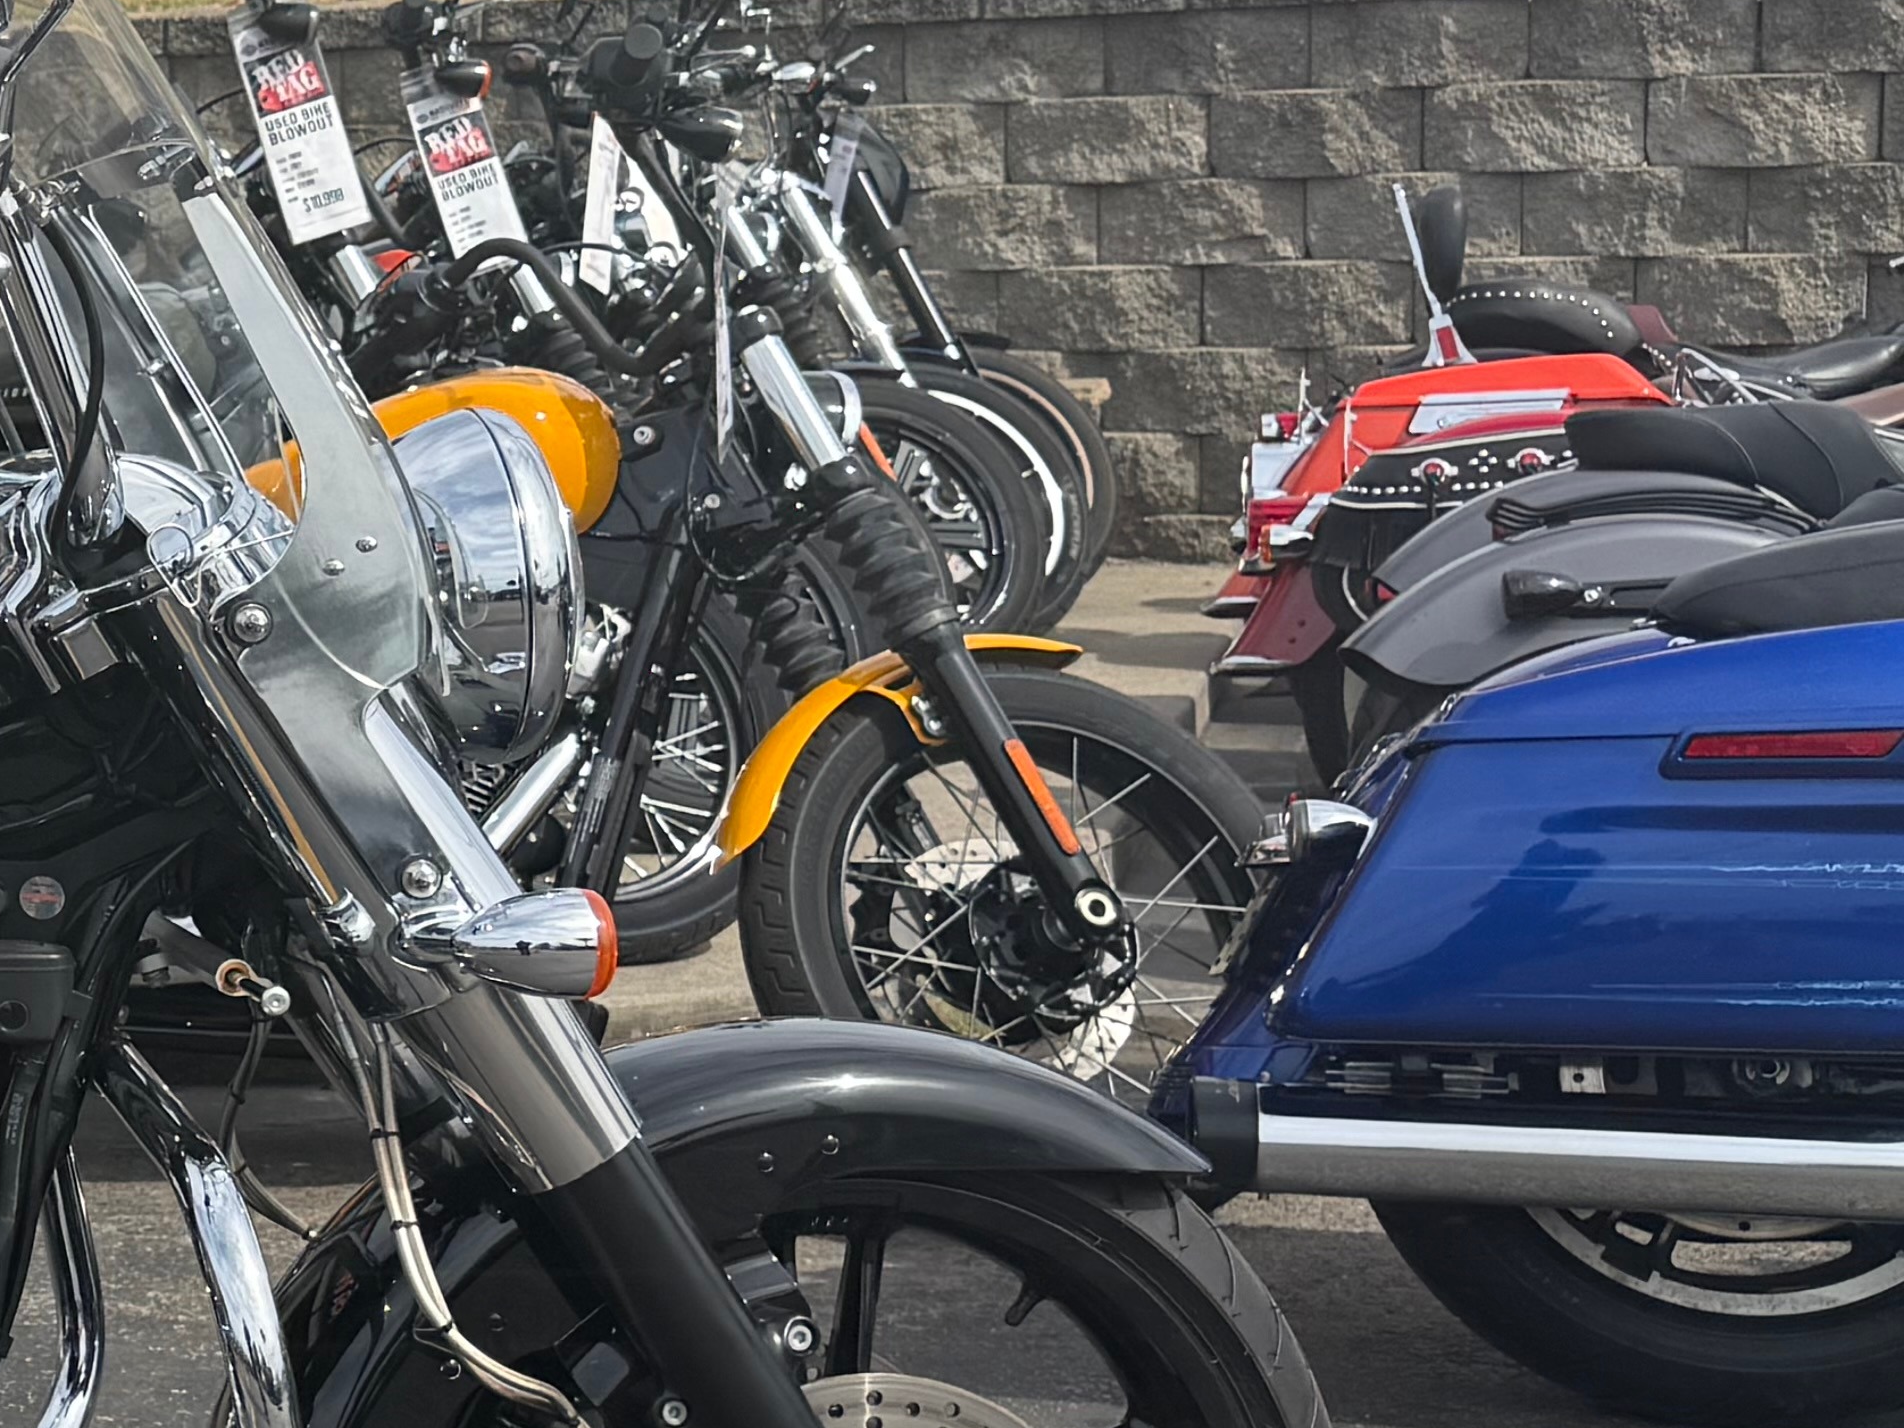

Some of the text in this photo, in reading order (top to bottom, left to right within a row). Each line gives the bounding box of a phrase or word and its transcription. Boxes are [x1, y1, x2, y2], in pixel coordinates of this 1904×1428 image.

[251, 49, 306, 88] RED
[273, 63, 320, 103] TAG
[264, 101, 331, 132] USED BIKE
[268, 113, 334, 147] BLOWOUT
[424, 116, 473, 154] RED
[443, 129, 487, 164] TAG
[437, 171, 467, 190] USED
[441, 171, 498, 202] BLOWOUT
